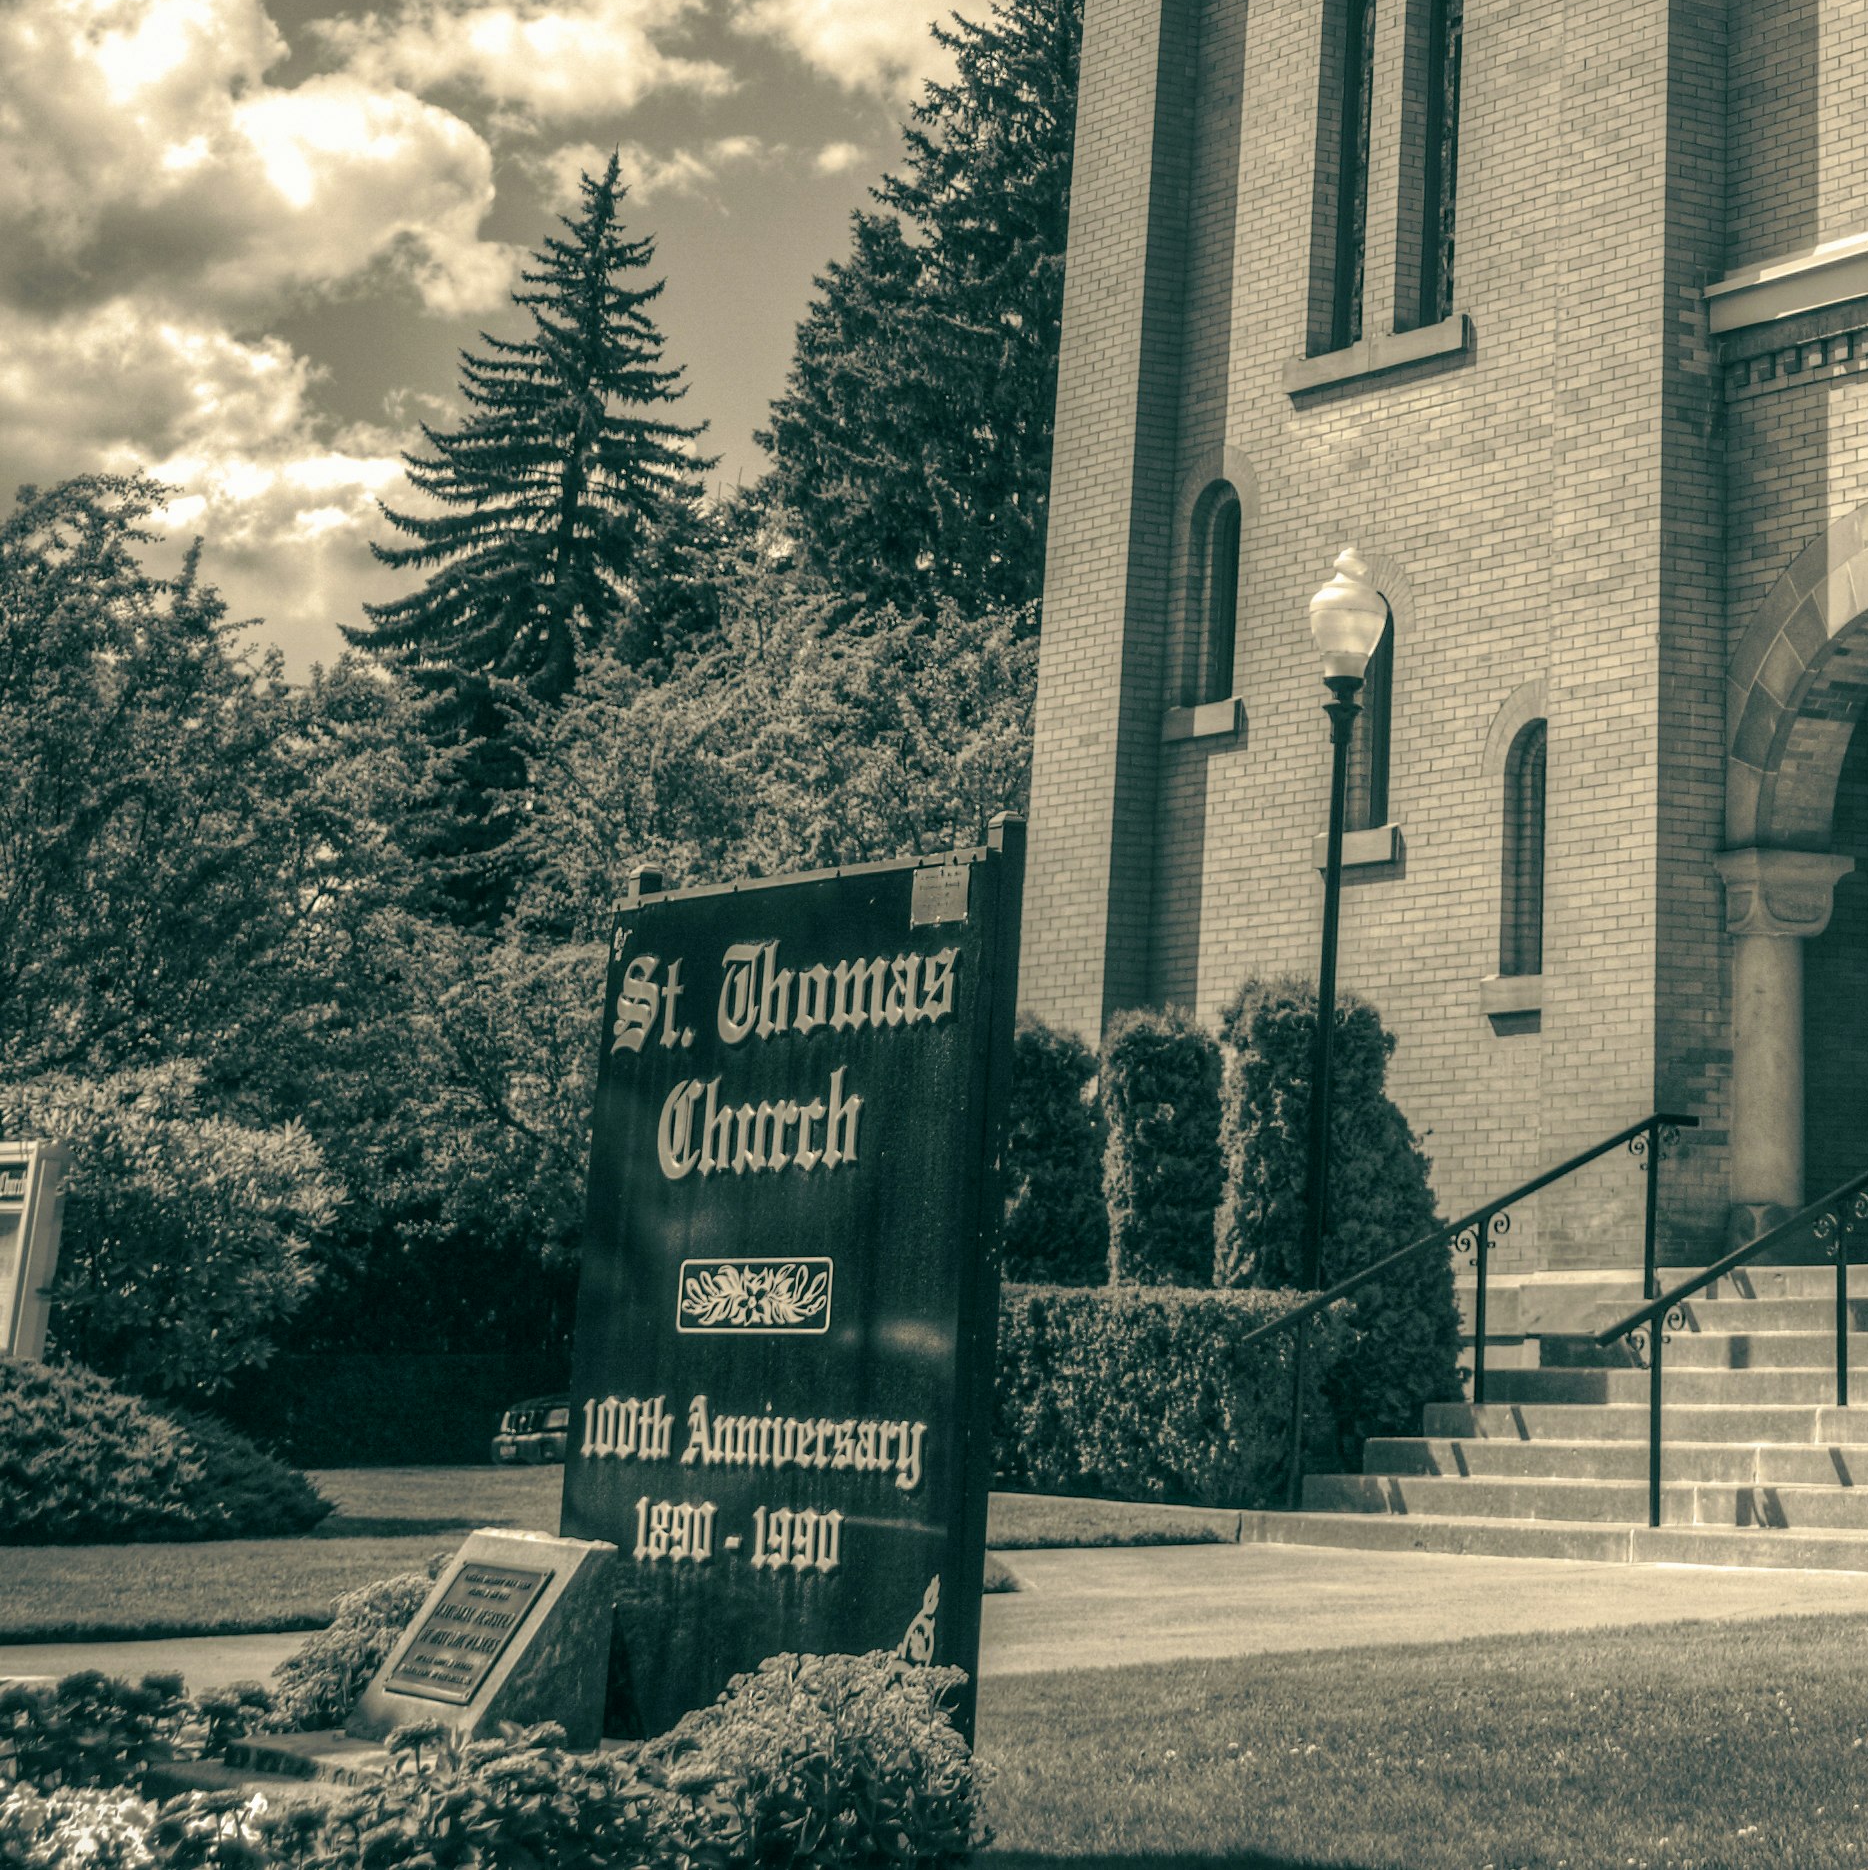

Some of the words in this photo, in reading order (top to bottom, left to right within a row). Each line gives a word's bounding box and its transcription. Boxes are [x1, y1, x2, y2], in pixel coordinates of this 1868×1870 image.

[611, 955, 696, 1055] St.
[717, 940, 960, 1044] Thomas
[658, 1065, 864, 1180] Church
[580, 1395, 675, 1459] 100th
[681, 1394, 927, 1490] Anniversary
[633, 1496, 717, 1562] 1890
[752, 1505, 844, 1573] 1990
